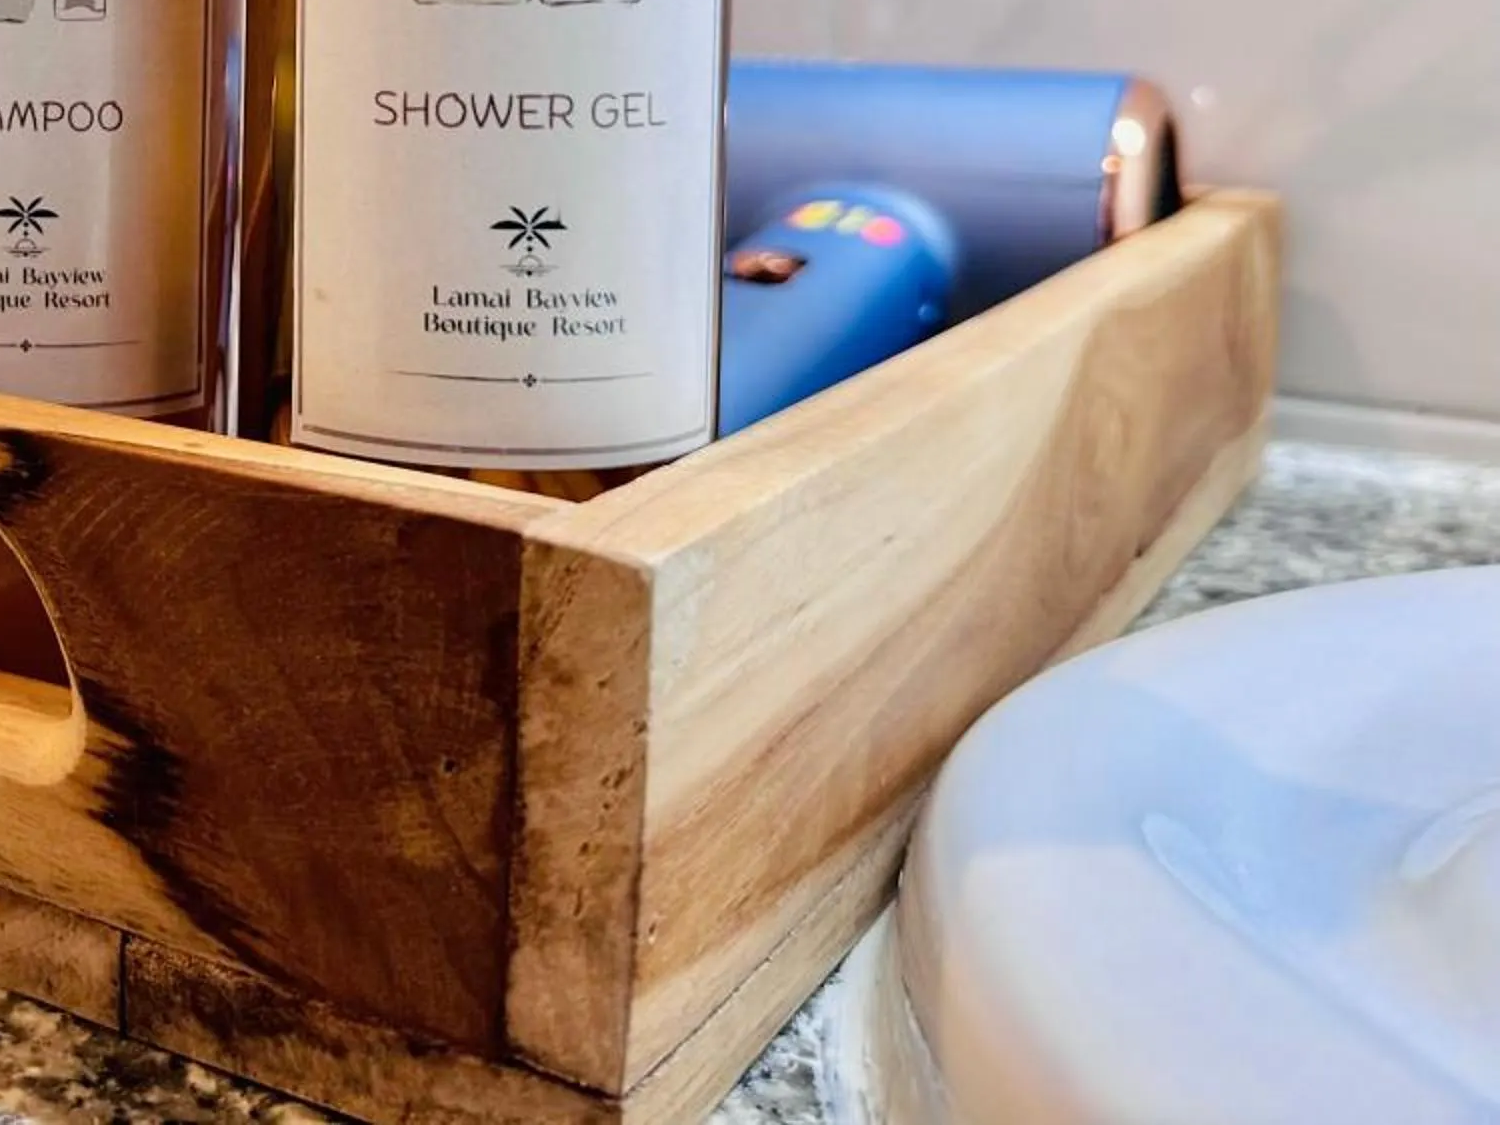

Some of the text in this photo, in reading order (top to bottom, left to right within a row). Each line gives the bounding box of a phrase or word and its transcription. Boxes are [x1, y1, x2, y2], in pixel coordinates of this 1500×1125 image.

[373, 91, 668, 129] SHOWER GEL
[23, 266, 105, 289] Bayview
[45, 291, 110, 308] Resort
[432, 285, 617, 309] Lamai Bayview
[423, 312, 627, 341] Boutique Resort
